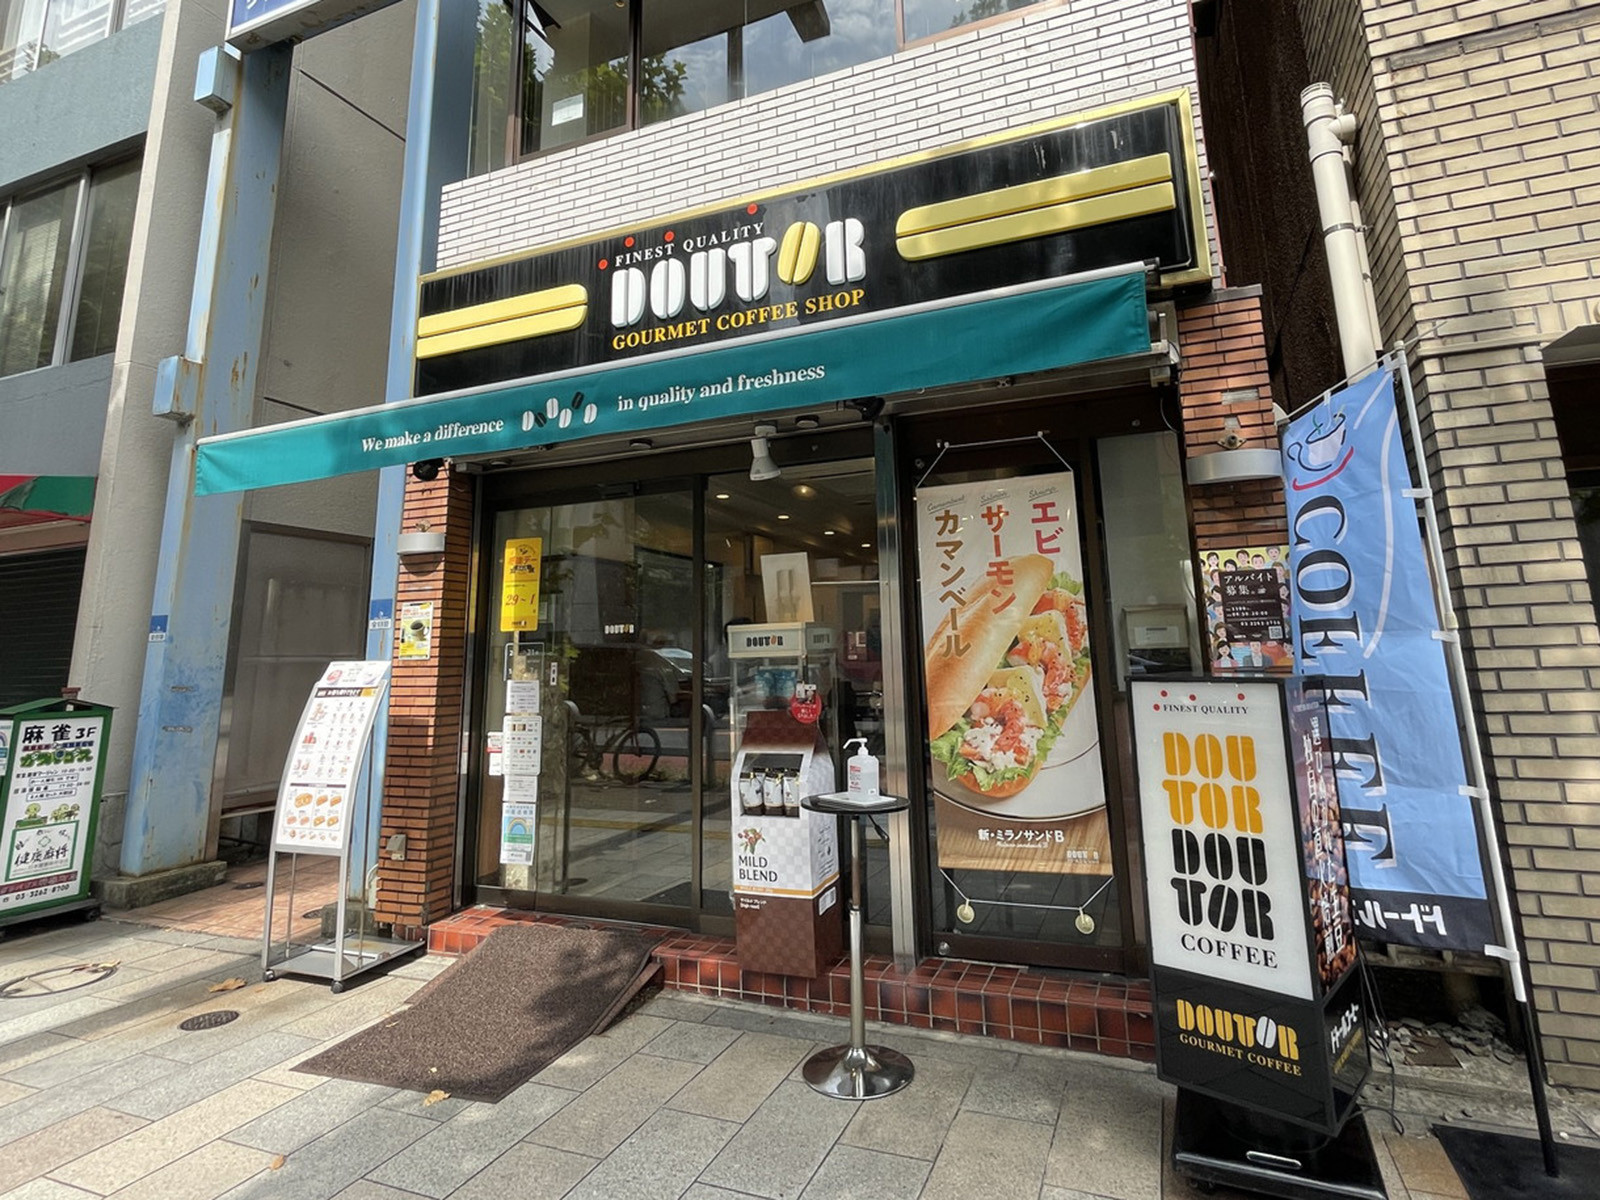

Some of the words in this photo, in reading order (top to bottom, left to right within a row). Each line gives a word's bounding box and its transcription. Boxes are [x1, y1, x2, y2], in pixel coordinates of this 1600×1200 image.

[614, 242, 675, 268] FINEST
[682, 221, 764, 253] QUALITY
[611, 218, 866, 328] DOUTOR
[612, 318, 711, 350] GOURMET
[716, 301, 799, 331] COFFEE
[805, 288, 866, 315] SHOP
[617, 395, 635, 412] in
[637, 384, 697, 411] quality
[699, 377, 734, 399] and
[736, 363, 826, 392] freshness
[361, 437, 383, 453] We
[384, 430, 422, 450] make
[423, 432, 433, 444] a
[434, 416, 504, 442] difference
[1031, 501, 1064, 554] エビ
[981, 504, 1017, 615] サーモン
[1223, 572, 1273, 584] アルバイト
[934, 509, 971, 658] カマンベール
[604, 624, 635, 635] DOUTOR
[746, 636, 784, 647] DOUTOR
[1163, 703, 1198, 714] FINEST
[1200, 704, 1249, 716] QUALITY
[22, 724, 71, 744] 麻雀
[75, 726, 97, 739] 3F
[1162, 732, 1257, 782] DOU
[1162, 780, 1263, 834] TOR
[977, 828, 1065, 843] 新・ミラノサンドB
[1171, 828, 1268, 886] DOU
[738, 855, 768, 868] MILD
[739, 869, 778, 883] BLEND
[1171, 878, 1274, 941] TOR
[1181, 933, 1278, 969] COFFEE
[1176, 998, 1300, 1060] DOUTOR
[1179, 1033, 1243, 1060] GOURMET
[1247, 1052, 1302, 1078] COFFEE
